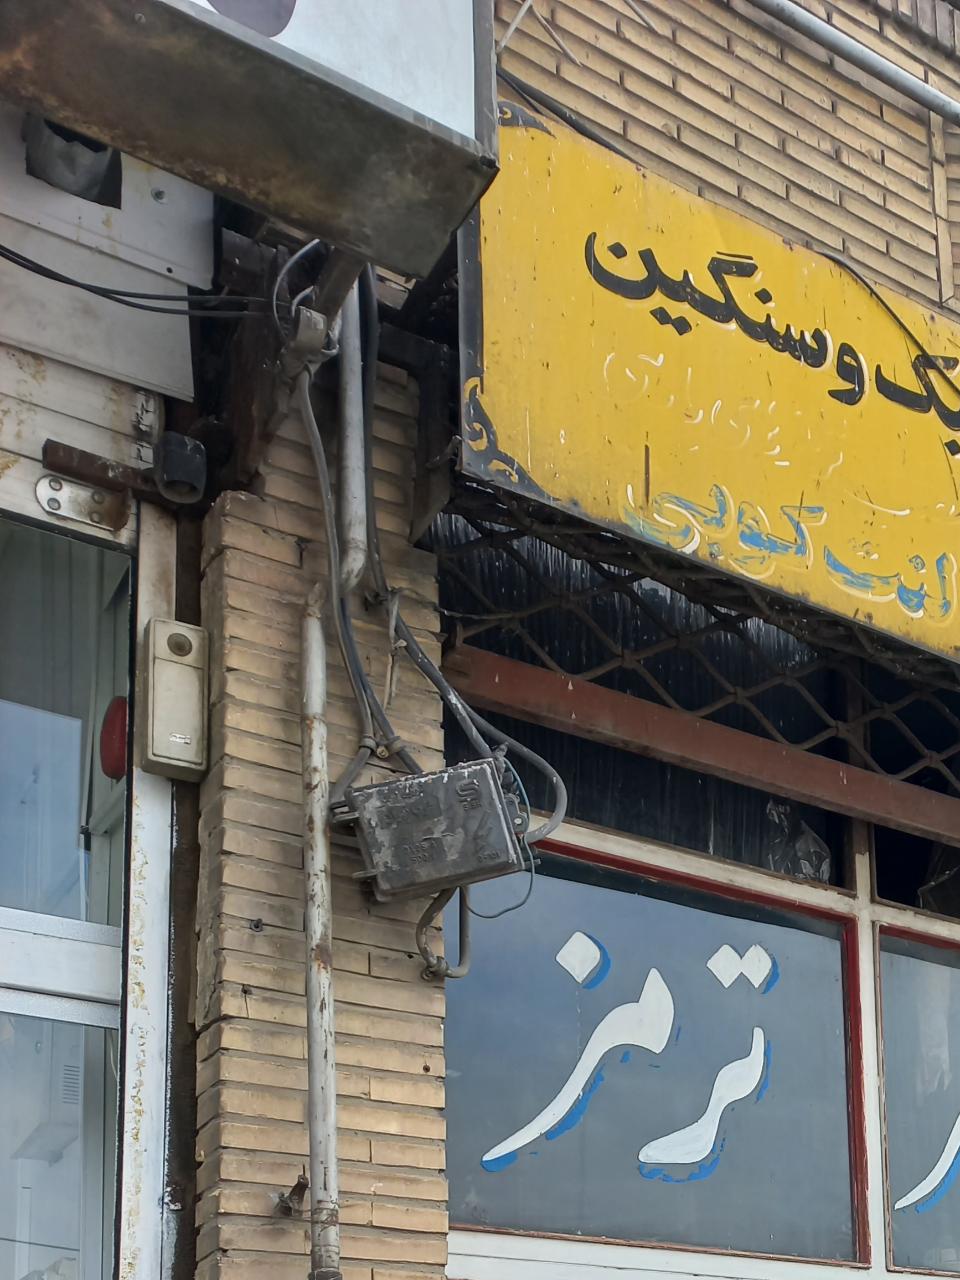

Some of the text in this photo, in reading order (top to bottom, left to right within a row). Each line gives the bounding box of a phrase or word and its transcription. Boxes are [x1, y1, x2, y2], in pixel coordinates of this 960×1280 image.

[584, 231, 830, 370] سنگین
[828, 341, 869, 405] و
[481, 930, 781, 1183] ترمز
